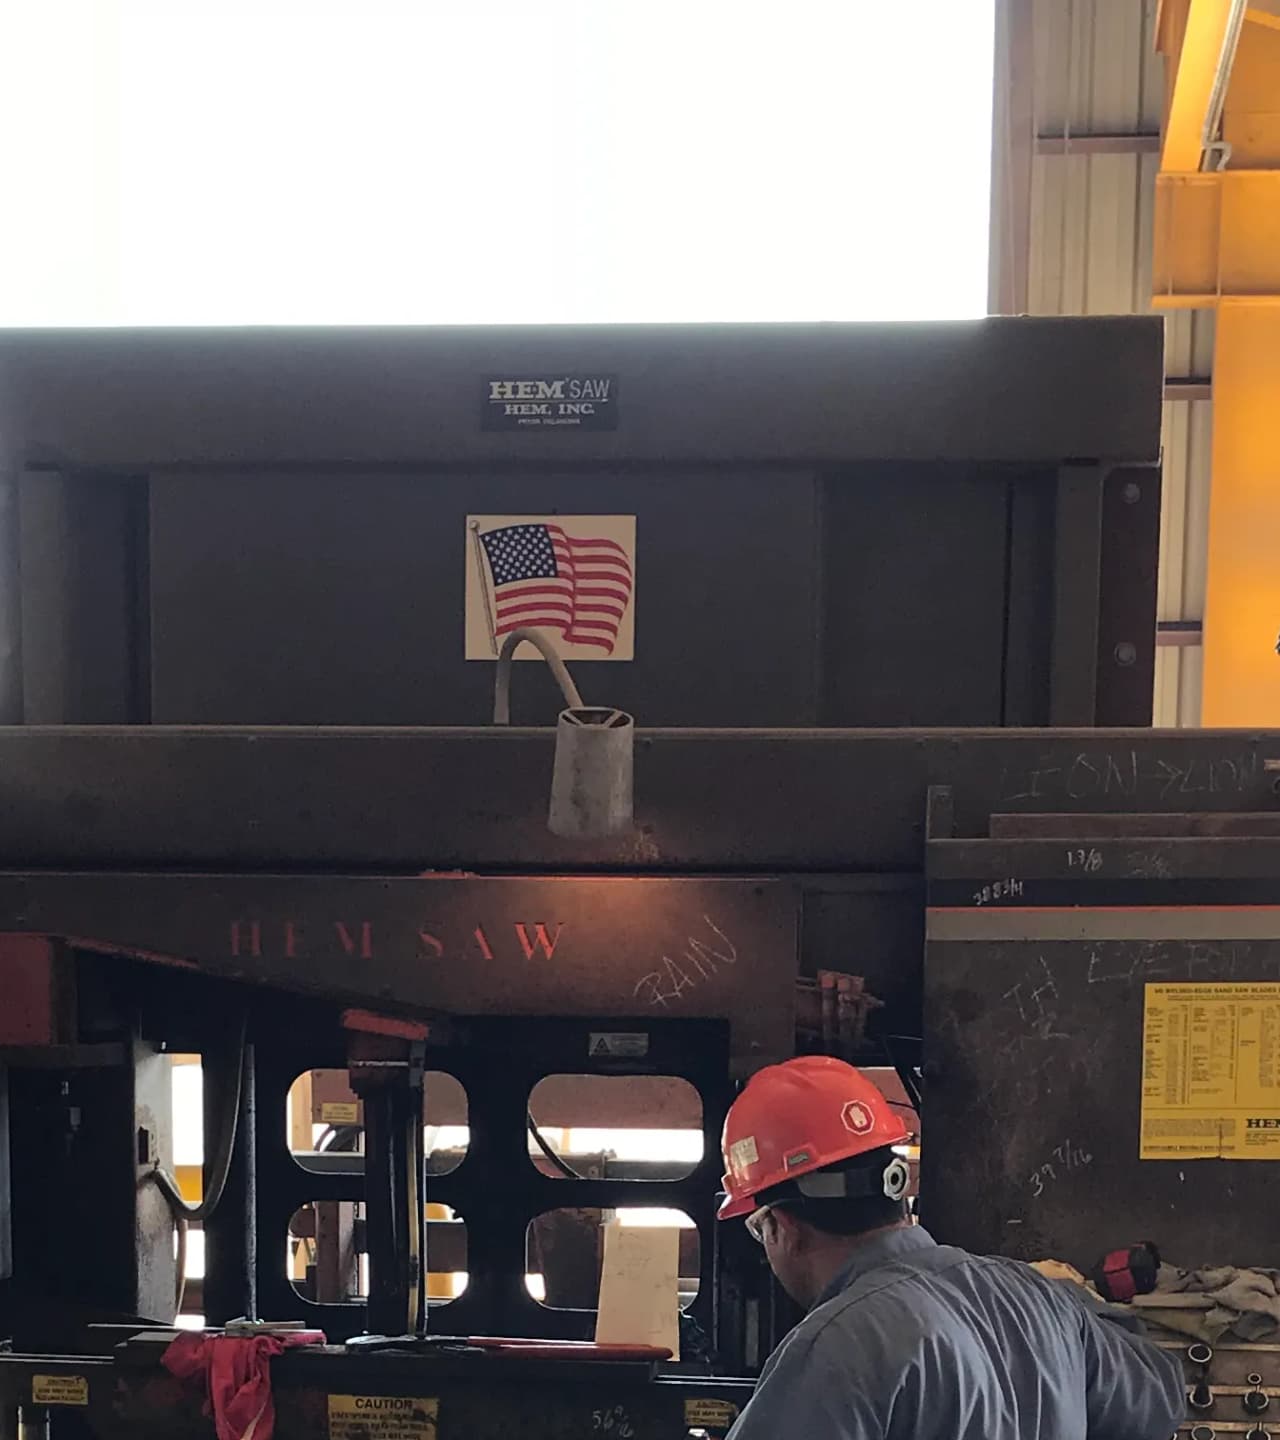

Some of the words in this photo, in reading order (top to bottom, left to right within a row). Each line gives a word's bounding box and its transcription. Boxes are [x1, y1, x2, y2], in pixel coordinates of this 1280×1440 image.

[489, 381, 565, 399] HEM
[569, 379, 610, 398] SAW
[558, 404, 595, 415] INC.
[230, 920, 375, 960] HEM
[416, 920, 565, 961] SAW
